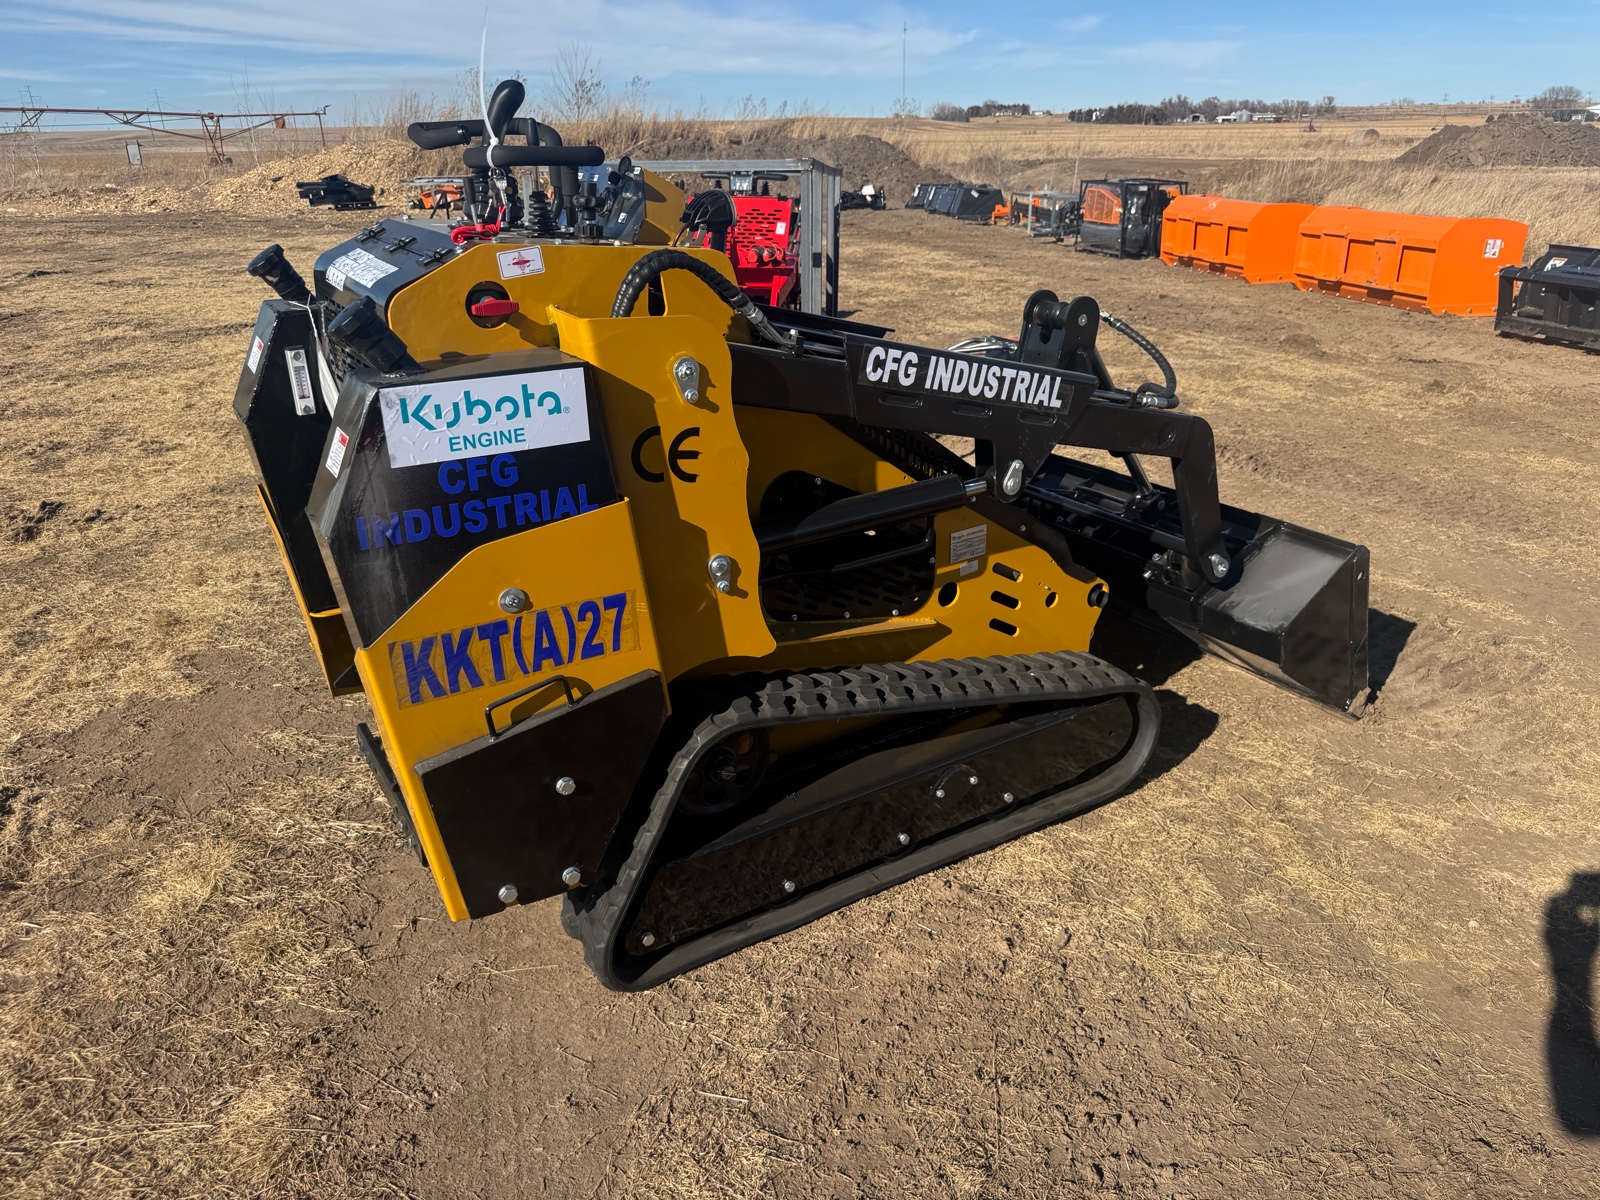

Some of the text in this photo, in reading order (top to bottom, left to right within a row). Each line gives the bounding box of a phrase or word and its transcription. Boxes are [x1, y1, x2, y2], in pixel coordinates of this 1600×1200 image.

[399, 383, 563, 431] Kubota
[866, 346, 1063, 409] CFG INDUSTRIAL
[448, 427, 527, 453] ENGINE
[631, 425, 702, 484] CE
[438, 453, 520, 495] CFG
[355, 483, 599, 551] INDUSTRIAL
[400, 592, 628, 705] KKT(A)27
